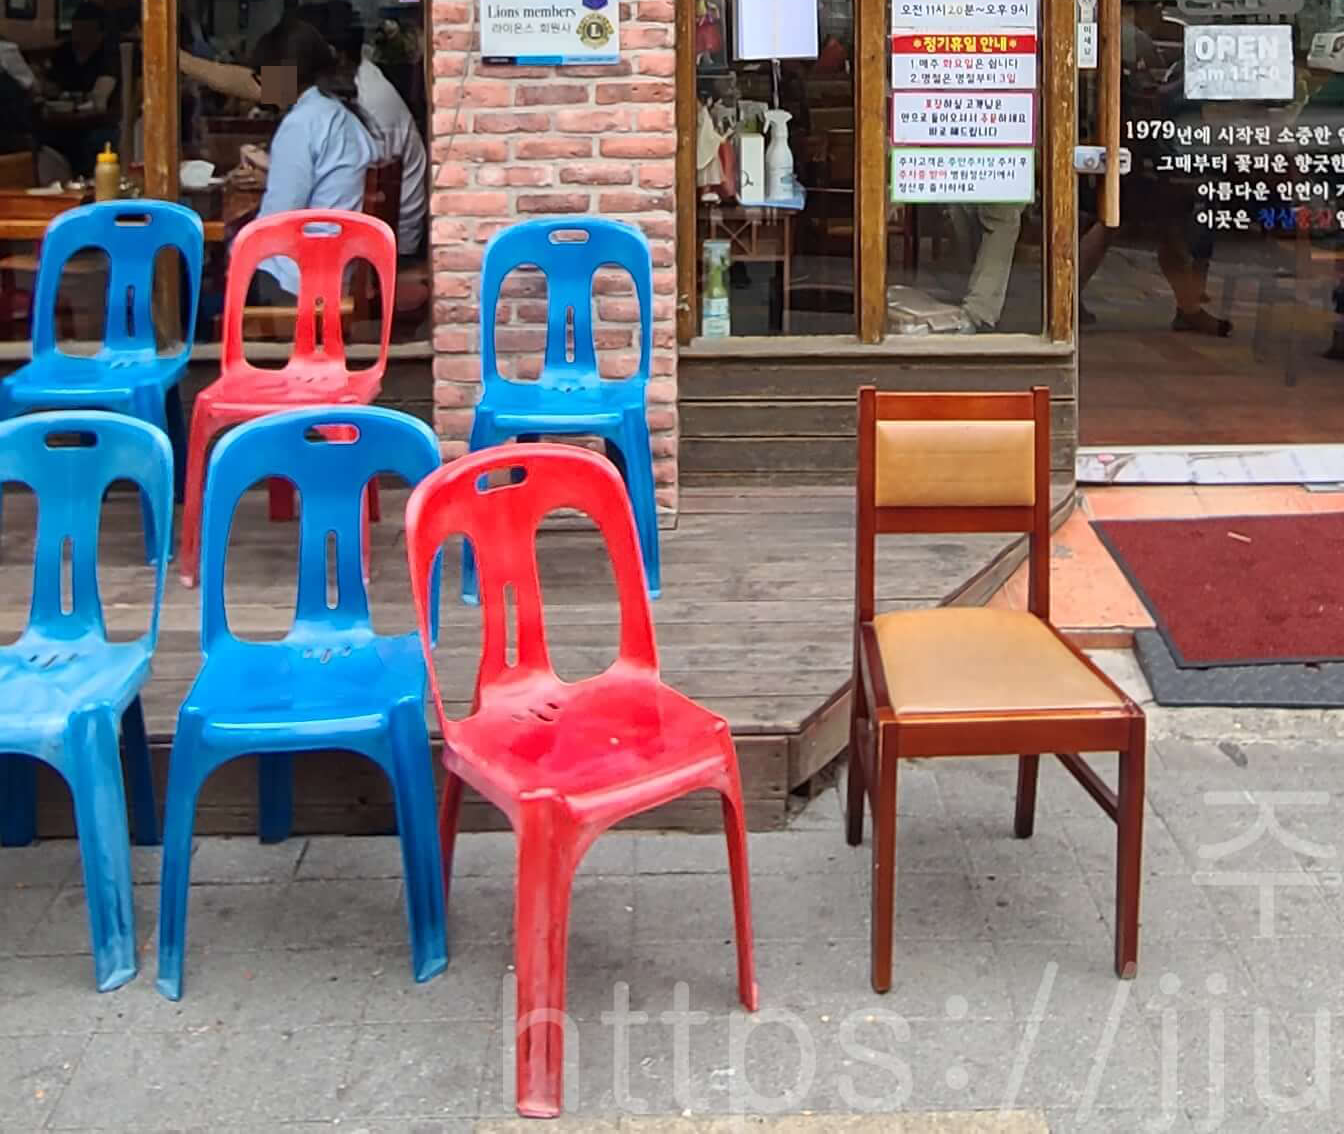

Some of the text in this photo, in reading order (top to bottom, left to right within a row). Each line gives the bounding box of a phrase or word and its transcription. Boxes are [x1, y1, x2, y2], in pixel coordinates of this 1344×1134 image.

[488, 5, 576, 18] Lions members
[901, 4, 922, 16] 오전
[1011, 4, 1028, 16] 9시
[492, 22, 535, 34] 라이온스
[923, 36, 1007, 52] 정기휴일 안내
[1196, 35, 1279, 60] OPEN
[919, 59, 939, 69] 매주
[988, 59, 1018, 69] 쉽니다
[1125, 121, 1210, 145] 1979년에
[1218, 126, 1270, 145] 시작된
[1277, 126, 1331, 145] 소중한
[1156, 154, 1227, 173] 그때부터
[1234, 154, 1288, 173] 꽃피운
[1198, 181, 1270, 201] 아름다운
[1277, 181, 1329, 201] 인연이
[1197, 209, 1250, 229] 이곳은
